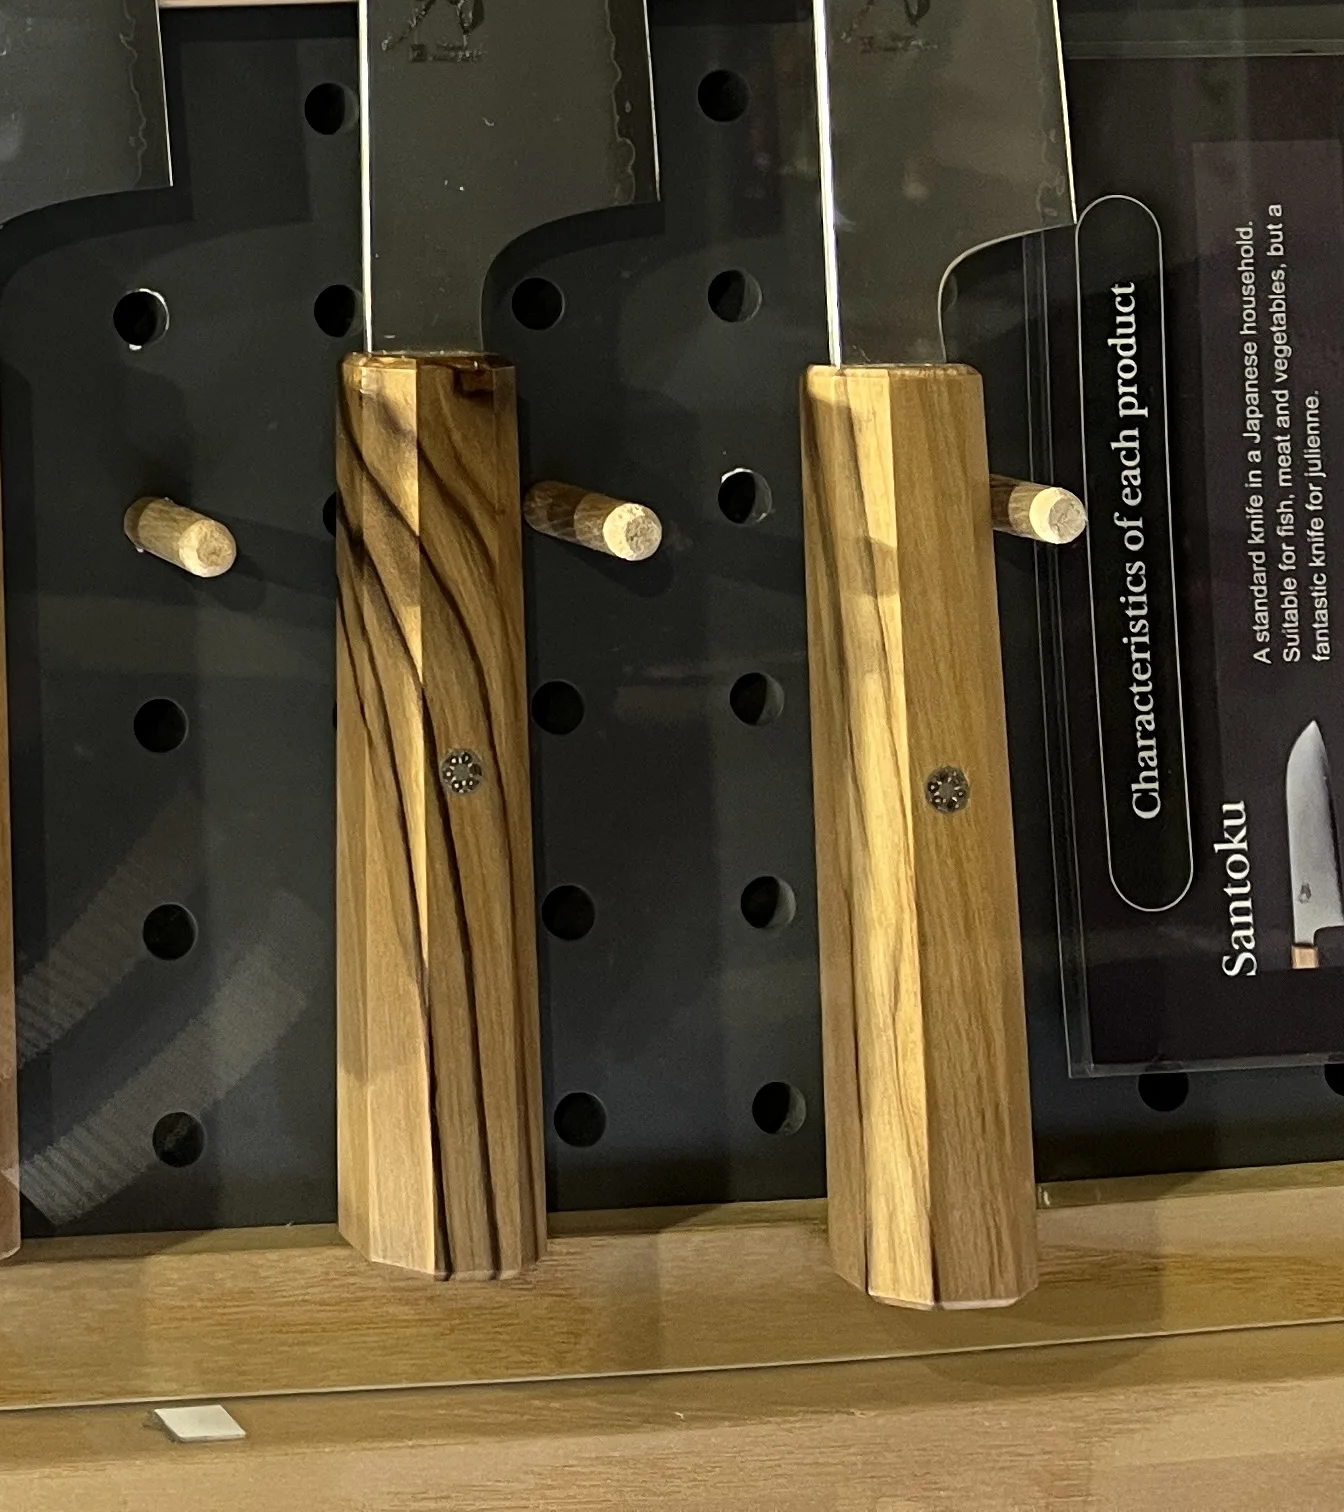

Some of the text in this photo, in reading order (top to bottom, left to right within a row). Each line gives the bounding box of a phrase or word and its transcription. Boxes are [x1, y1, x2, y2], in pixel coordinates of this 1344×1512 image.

[1108, 282, 1161, 819] Characteristics of each product
[1236, 221, 1272, 664] A standard knife in a Japanese household.
[1267, 205, 1301, 662] Suitable for fish, meat and vegetables, but a
[1304, 390, 1331, 662] fantastic knife for julienne.
[1214, 800, 1258, 977] Santoku
